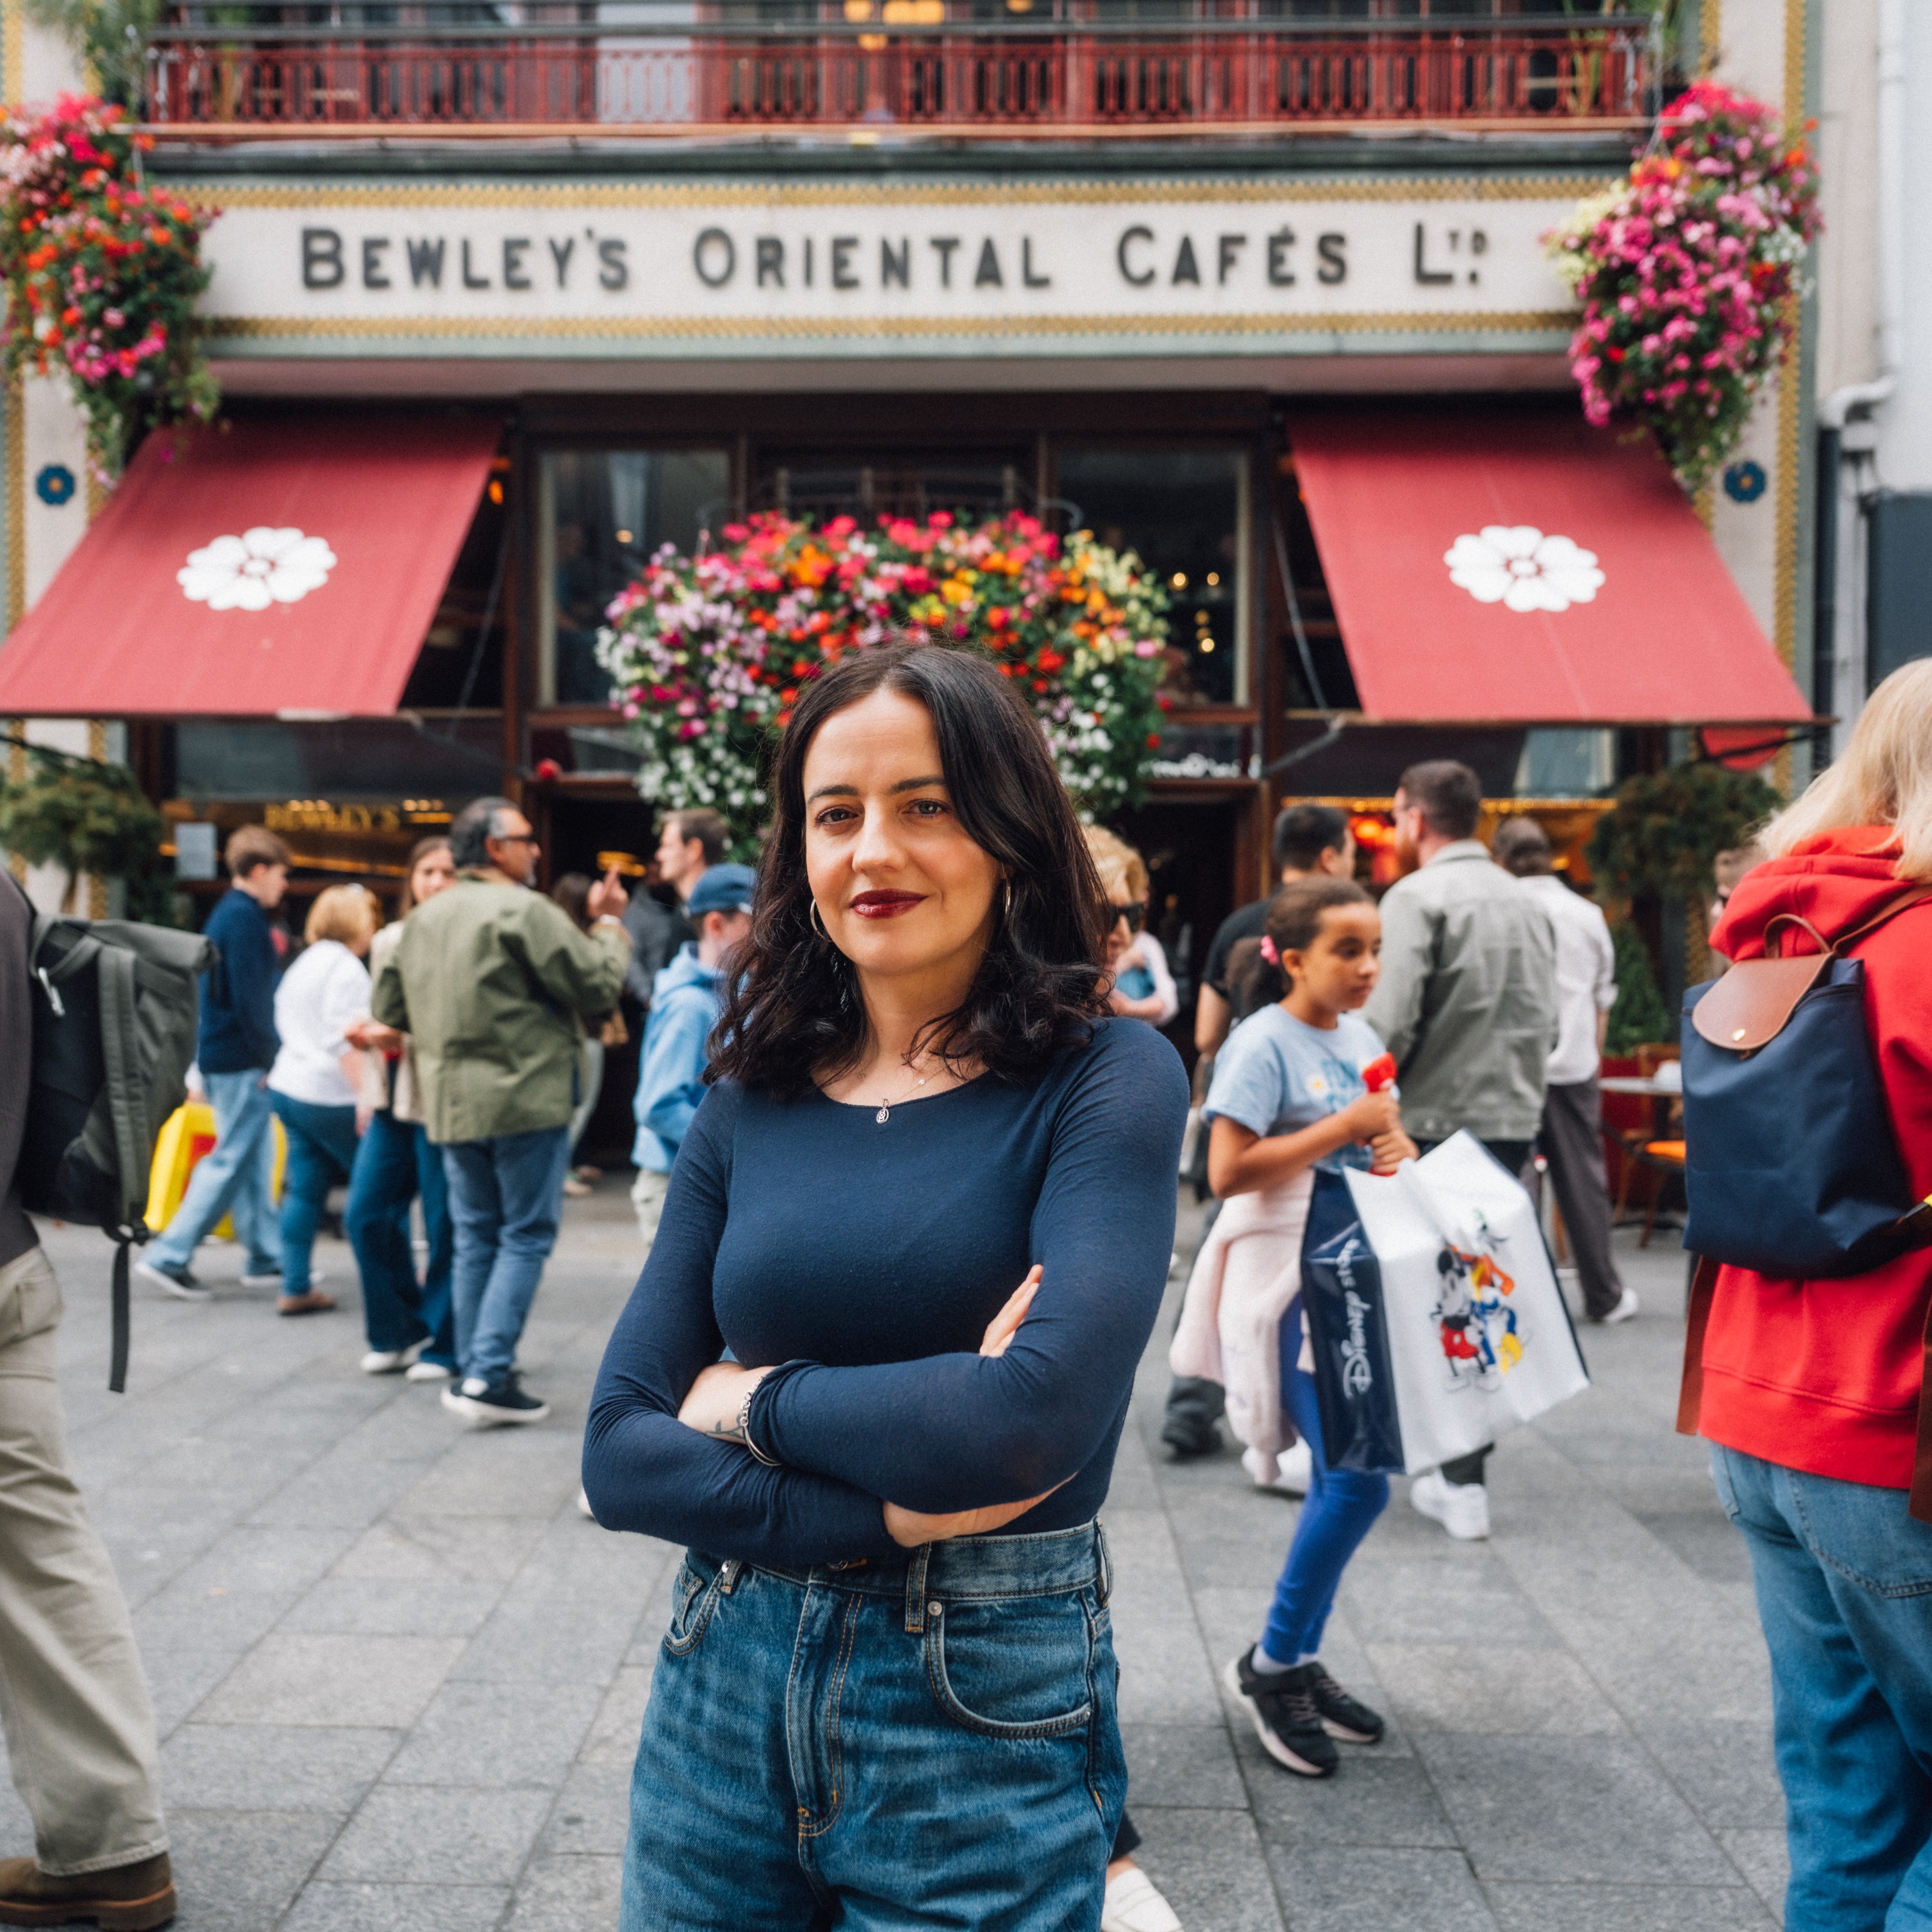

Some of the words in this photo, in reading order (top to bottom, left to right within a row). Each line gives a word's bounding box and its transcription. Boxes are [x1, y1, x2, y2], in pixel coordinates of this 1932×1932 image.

[301, 227, 628, 290] BEWLEY'S
[692, 227, 1051, 290] ORIENTAL
[1116, 225, 1347, 287] CAFÉS
[1340, 1291, 1374, 1399] Disney
